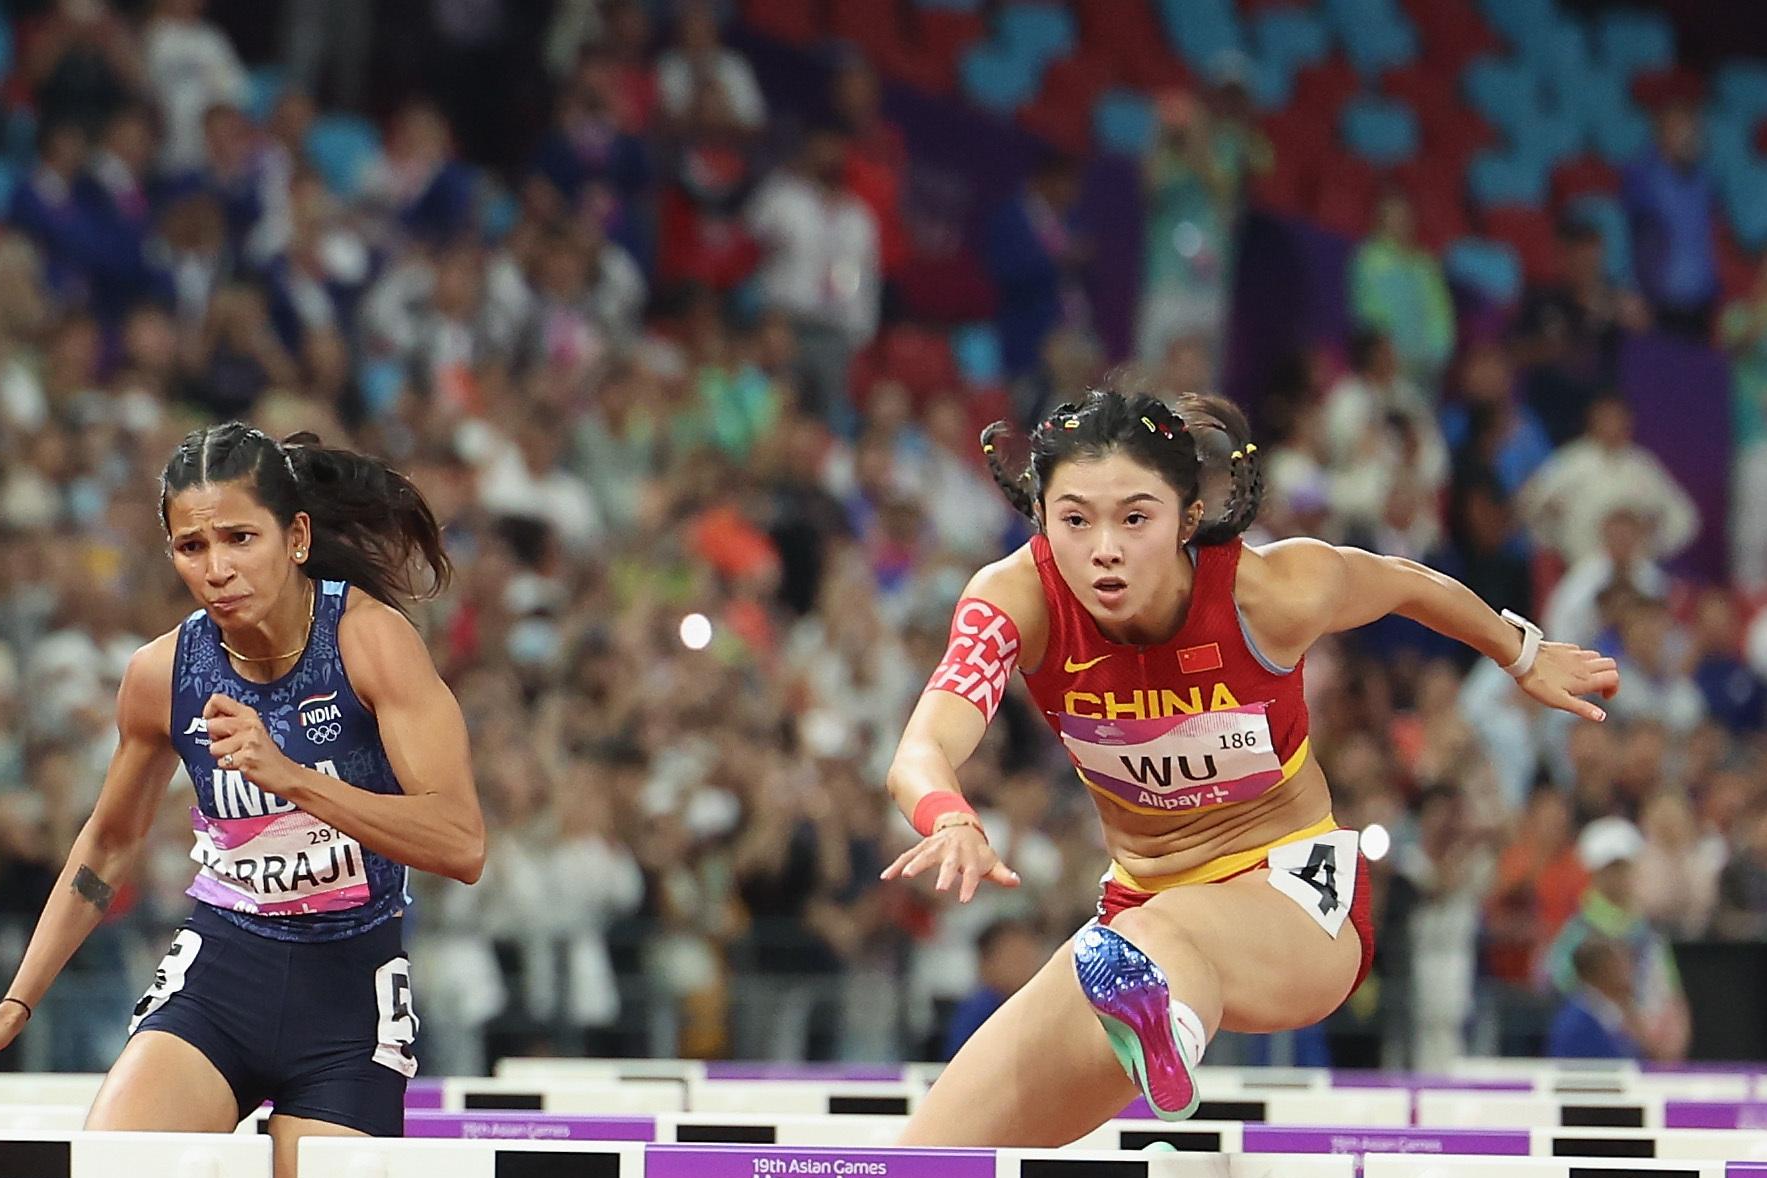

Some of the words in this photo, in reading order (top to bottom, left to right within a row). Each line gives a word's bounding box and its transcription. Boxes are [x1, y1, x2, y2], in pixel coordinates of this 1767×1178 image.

[299, 704, 342, 727] INDIA
[1064, 682, 1241, 720] CHINA
[1218, 730, 1257, 750] 186
[1120, 754, 1219, 787] WU
[202, 844, 357, 895] YRRAJI
[1288, 843, 1339, 917] 4
[752, 1158, 786, 1173] 19th
[788, 1159, 832, 1174] Asian
[833, 1160, 887, 1175] Games
